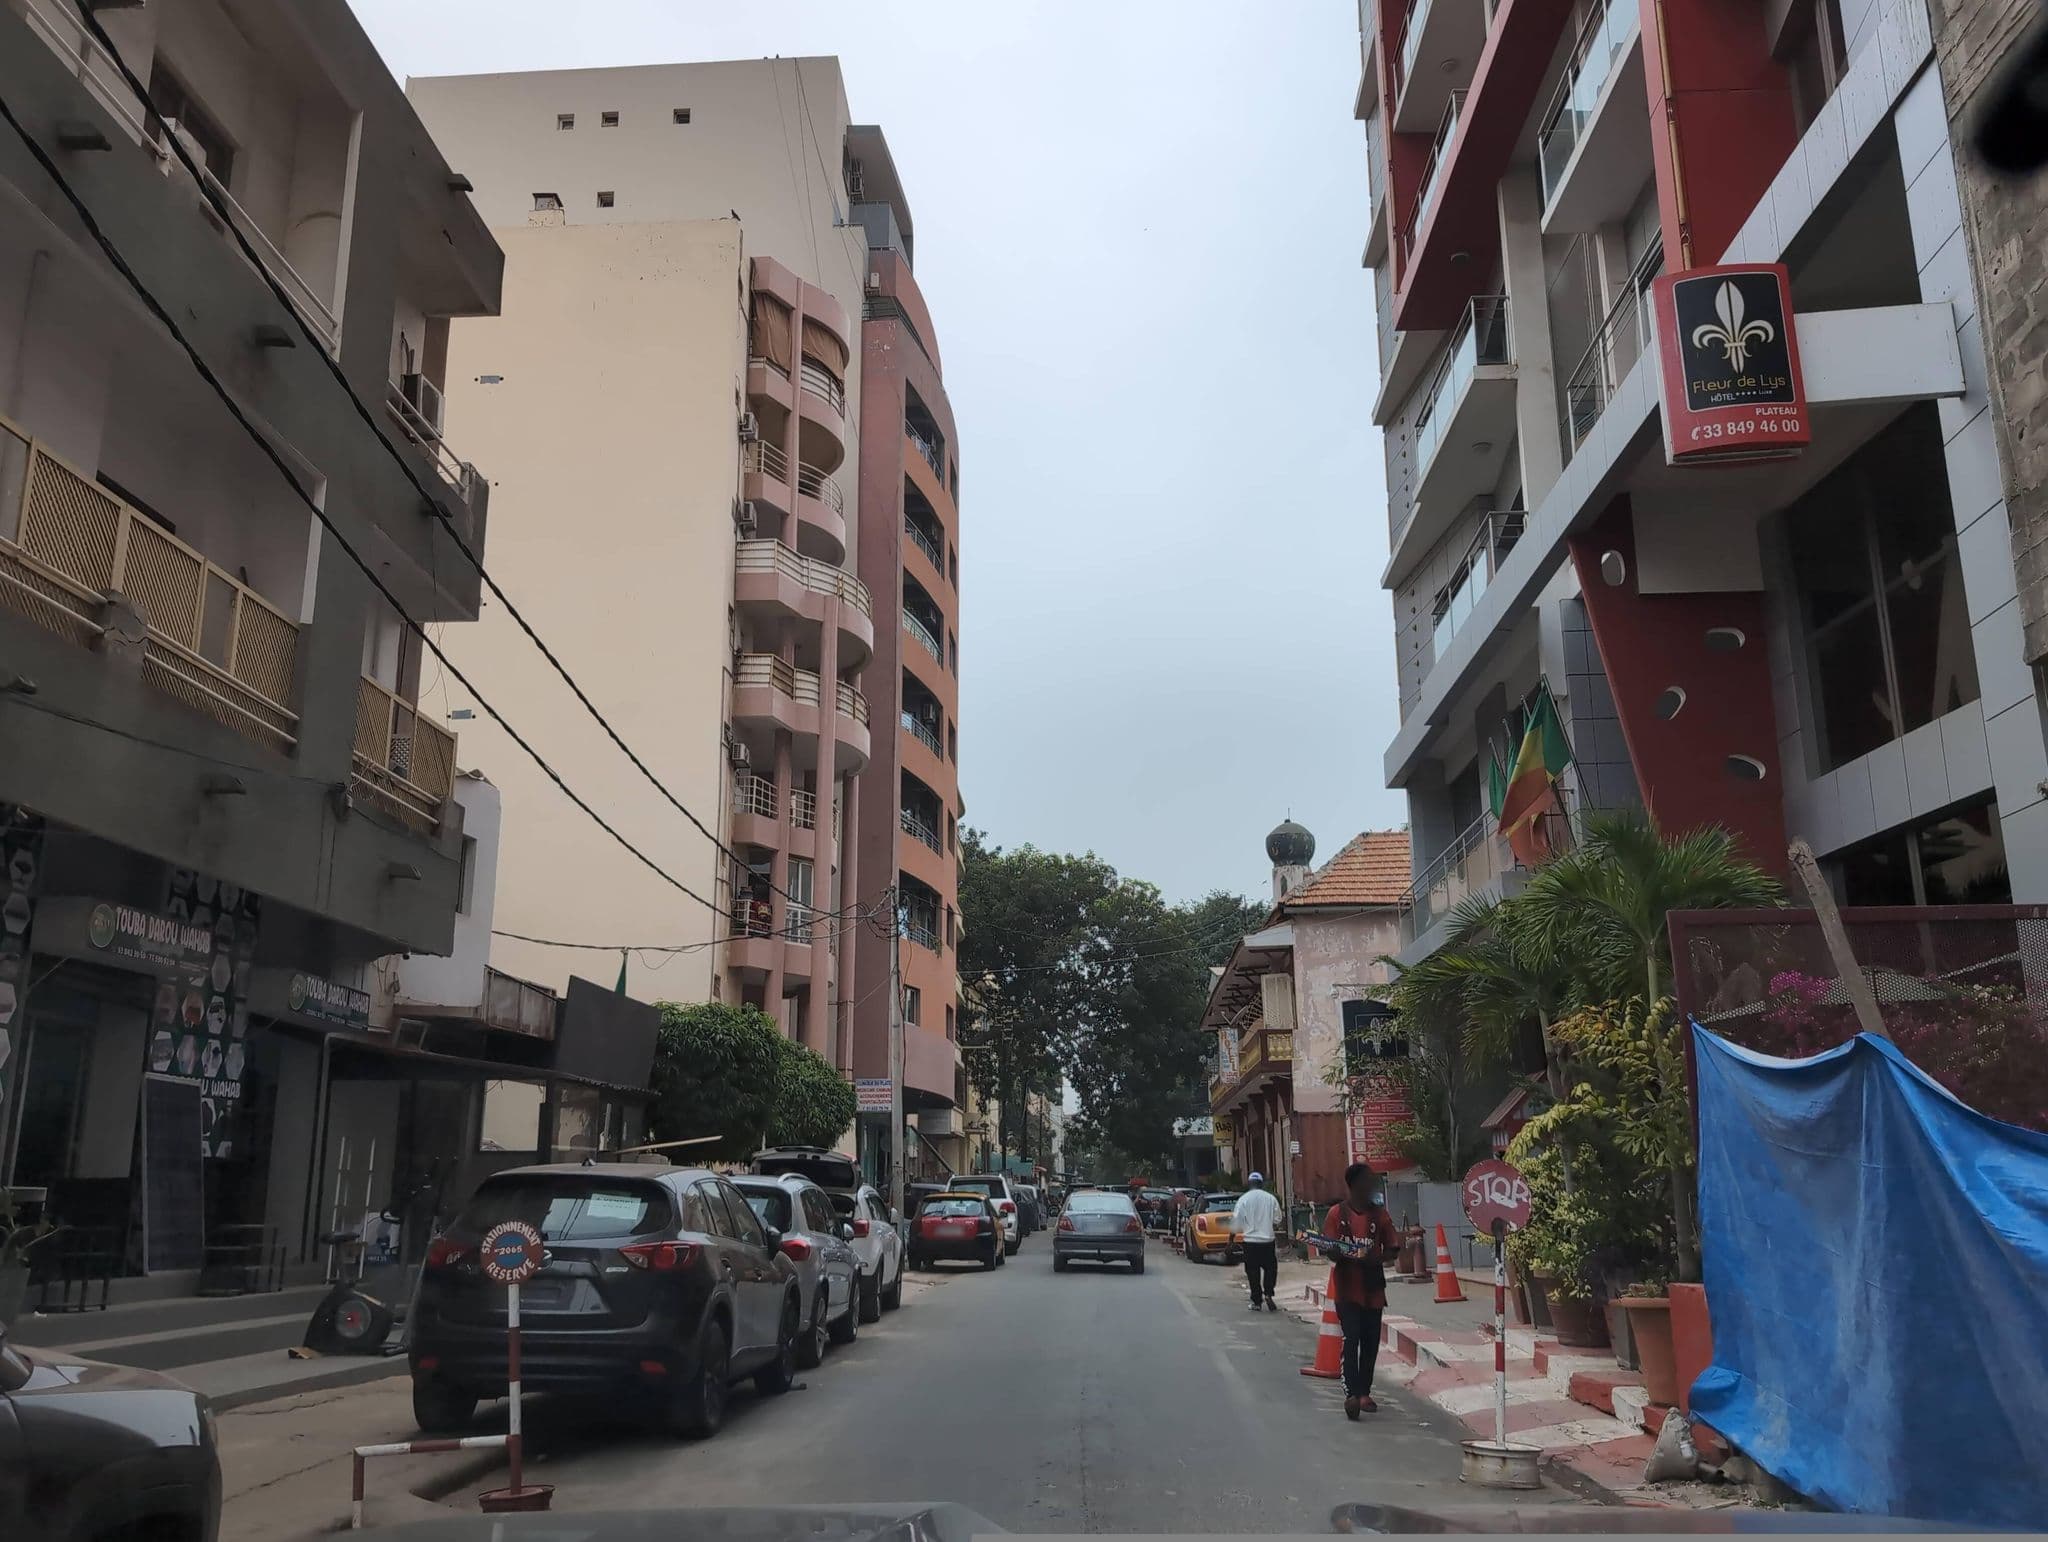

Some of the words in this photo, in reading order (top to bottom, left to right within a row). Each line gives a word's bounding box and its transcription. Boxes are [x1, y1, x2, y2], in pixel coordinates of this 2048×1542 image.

[1692, 379, 1732, 394] Fleur
[1737, 376, 1756, 388] de
[1760, 374, 1786, 389] Lys
[1710, 392, 1737, 403] HÔTEL
[1755, 407, 1797, 416] PLATEAU
[1703, 424, 1722, 439] 33
[1727, 420, 1755, 436] 849
[1760, 420, 1778, 433] 46
[1782, 419, 1800, 433] 00
[115, 906, 146, 937] TOUBA
[149, 916, 179, 946] DAROU
[180, 925, 211, 954] WAHAB
[306, 976, 327, 1001] TOUBA
[328, 984, 349, 1008] DAROU
[211, 1080, 241, 1099] WAHAB
[481, 1221, 541, 1254] STATIONNEMENT
[486, 1258, 535, 1281] RESERVE
